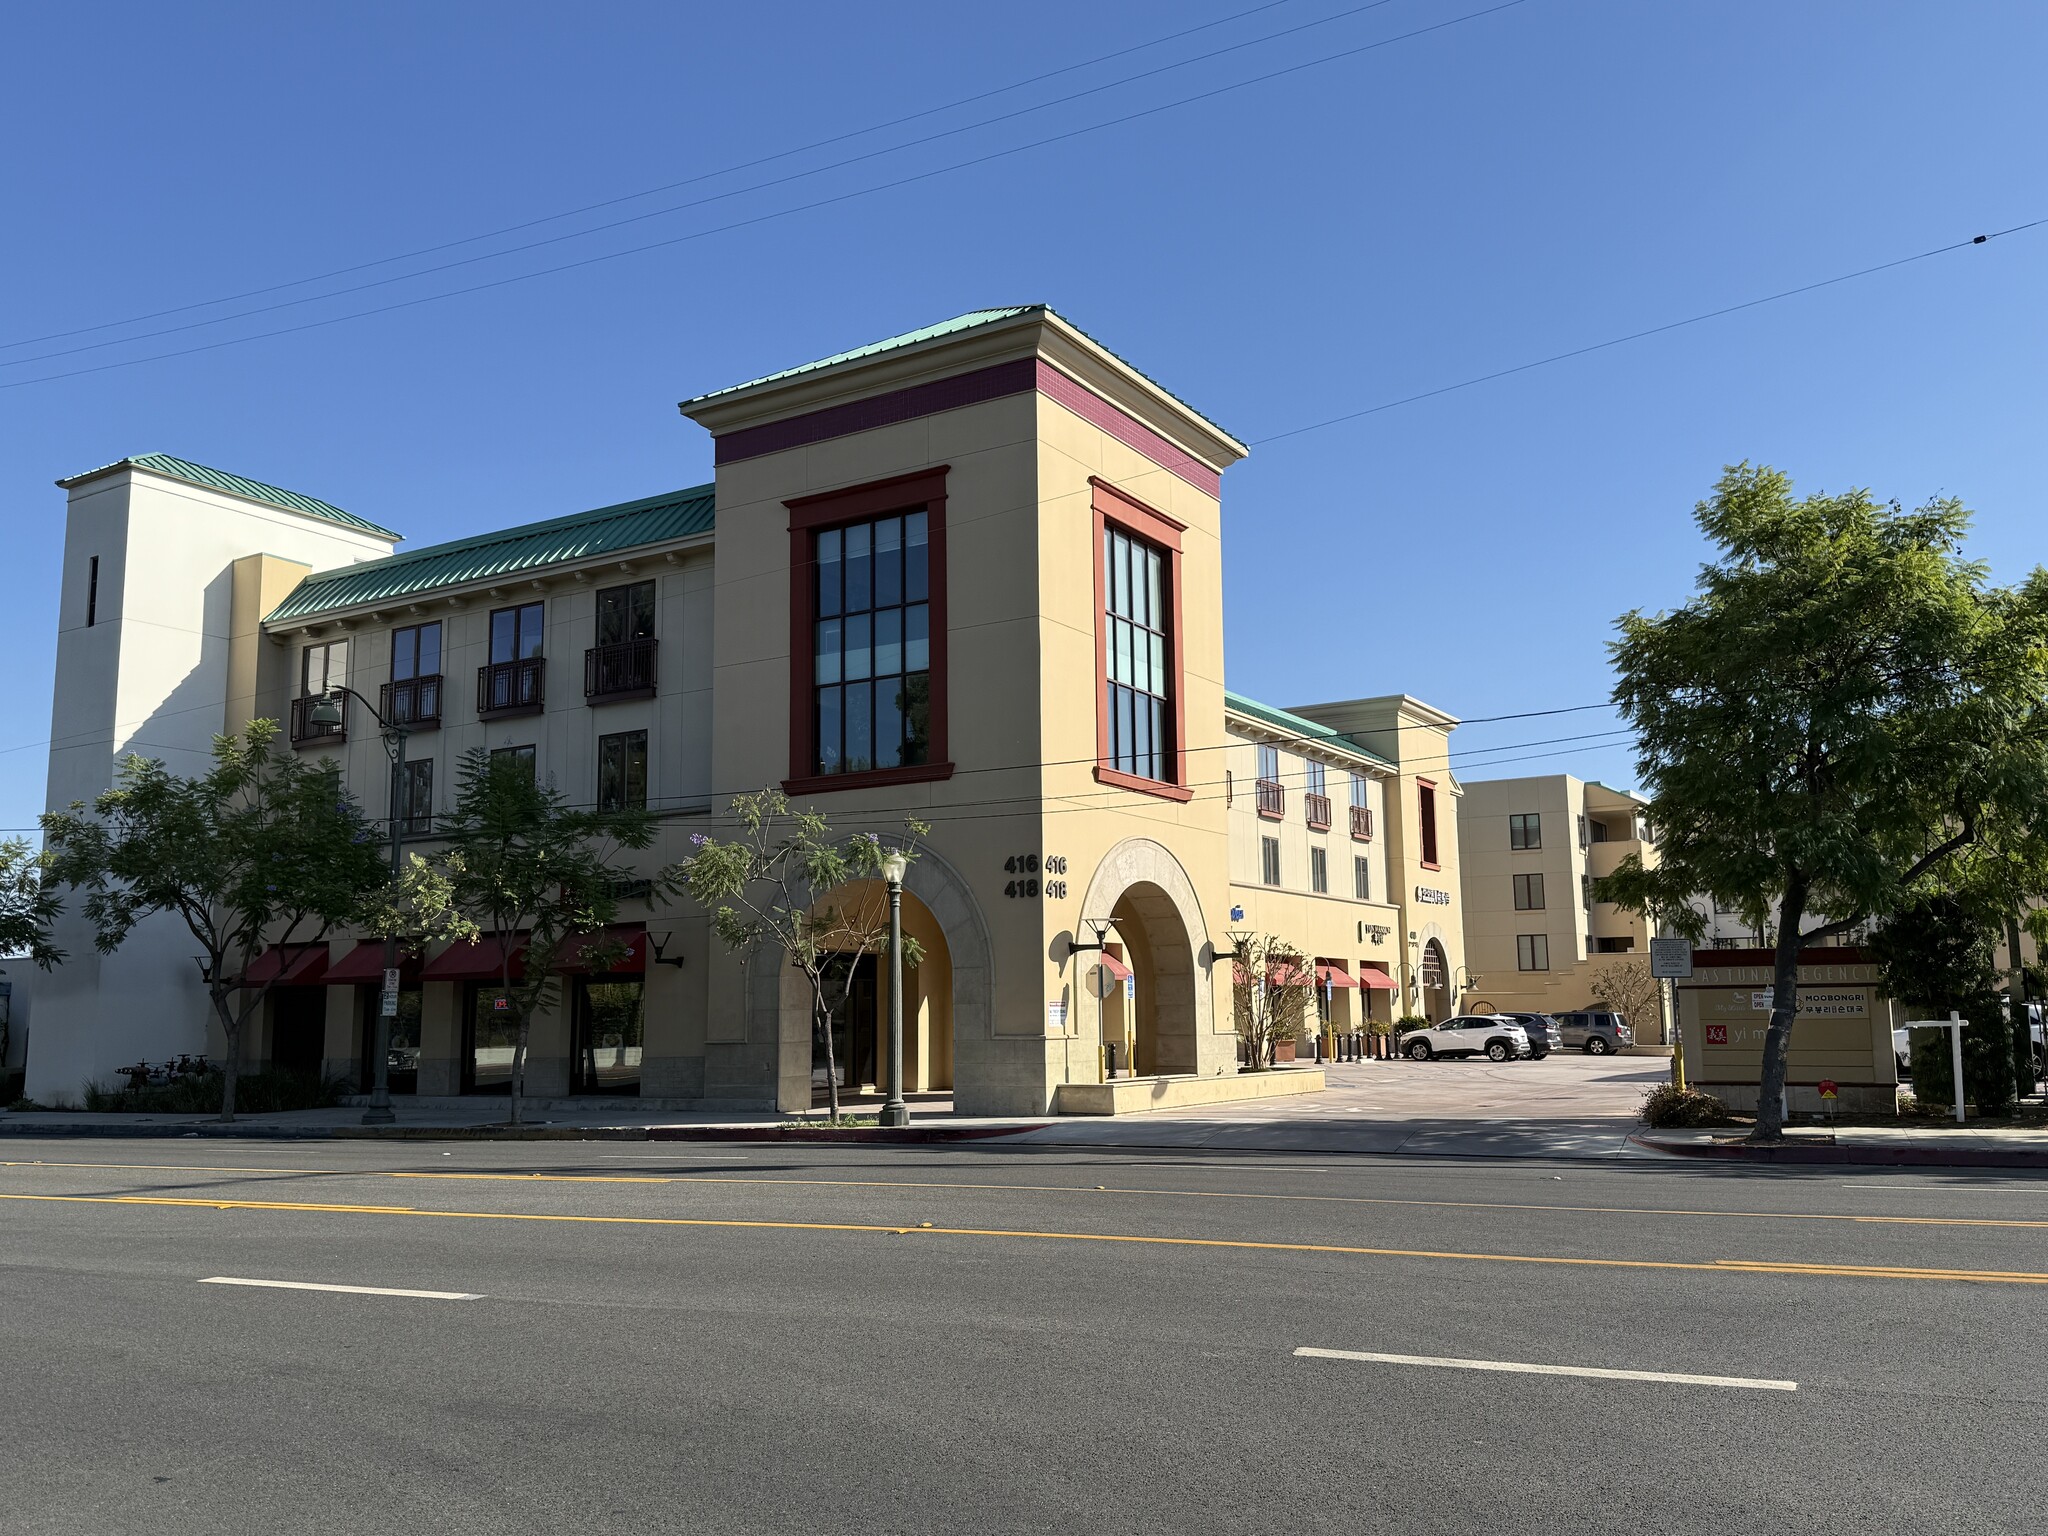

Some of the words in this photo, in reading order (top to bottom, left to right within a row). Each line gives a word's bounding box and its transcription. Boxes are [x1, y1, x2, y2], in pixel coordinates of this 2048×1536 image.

[1004, 854, 1039, 874] 416
[1045, 855, 1067, 875] 416
[1004, 879, 1039, 898] 418
[1045, 879, 1067, 899] 418
[1727, 967, 1771, 982] TUNA
[1801, 966, 1871, 981] EGENCY
[1805, 994, 1865, 1002] MOOBONGRI
[1734, 1027, 1747, 1043] yi
[1752, 1029, 1767, 1040] m
